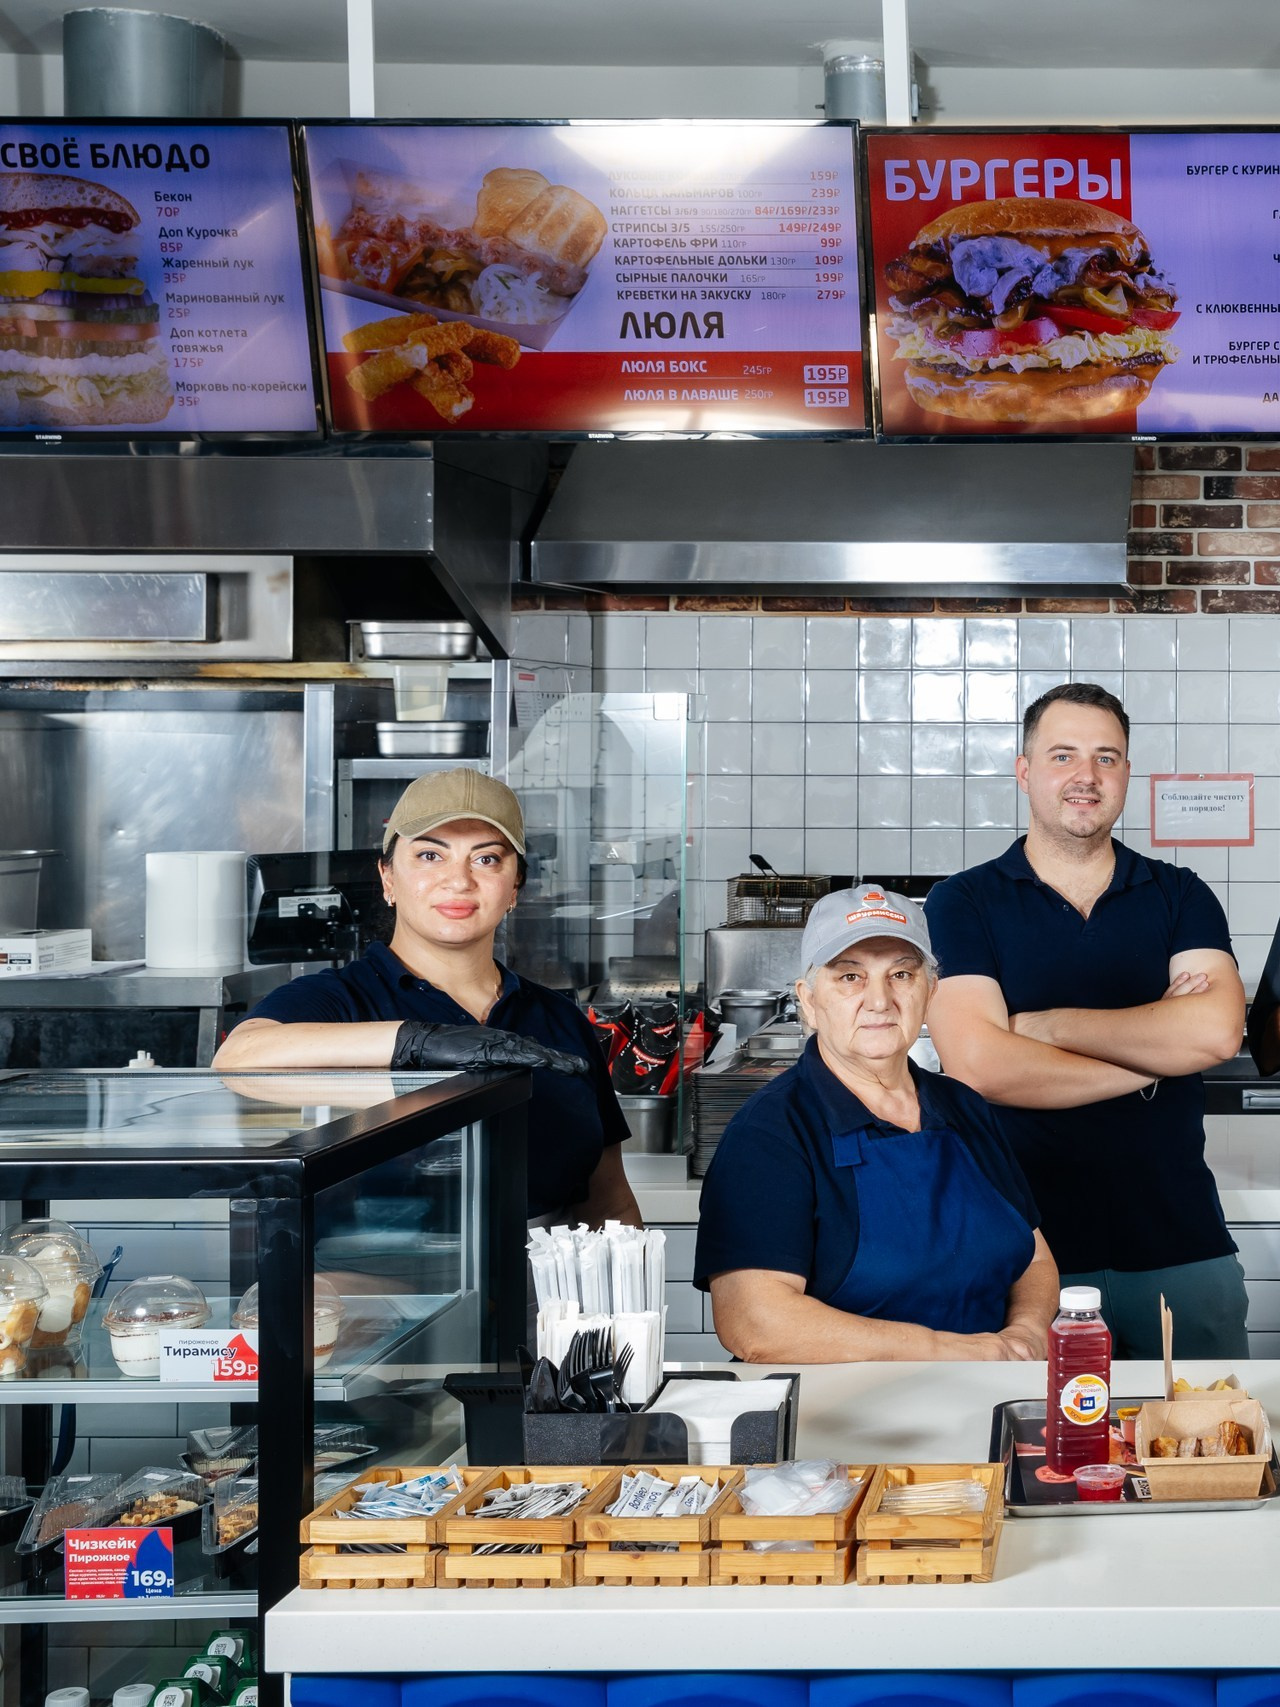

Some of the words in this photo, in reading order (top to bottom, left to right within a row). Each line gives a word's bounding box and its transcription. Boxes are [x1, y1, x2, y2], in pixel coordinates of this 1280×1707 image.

[1, 137, 80, 168] СВОЁ
[90, 143, 210, 172] БЛЮДО
[1186, 165, 1229, 175] БУРГЕР
[1232, 165, 1238, 175] С
[884, 159, 1122, 201] БУРГЕРЫ
[154, 191, 192, 202] Бекон
[611, 205, 671, 215] НАГГЕТСЫ
[158, 227, 183, 239] Доп
[187, 227, 238, 239] Курочка
[611, 223, 667, 233] СТРИПСЫ
[671, 223, 690, 233] 3/5
[613, 238, 687, 248] КАРТОФЕЛЬ
[690, 237, 718, 248] ФРИ
[162, 257, 229, 270] Жаренный
[235, 260, 254, 270] лук
[614, 255, 715, 266] КАРТОФЕЛЬНЫЕ
[717, 255, 768, 267] ДОЛЬКИ
[615, 273, 668, 283] СЫРНЫЕ
[671, 273, 728, 283] ПАЛОЧКИ
[166, 292, 259, 304] Маринованный
[264, 294, 285, 305] лук
[617, 290, 677, 300] КРЕВЕТКИ
[681, 290, 697, 300] НА
[700, 290, 752, 300] ЗАКУСКУ
[1196, 304, 1202, 313] С
[619, 311, 724, 339] ЛЮЛЯ
[170, 327, 196, 340] Доп
[198, 329, 248, 339] котлета
[171, 343, 224, 354] говяжья
[1229, 341, 1270, 350] БУРГЕР
[1274, 341, 1279, 350] С
[1193, 355, 1200, 364] И
[621, 361, 665, 373] ЛЮЛЯ
[669, 360, 707, 373] БОКС
[176, 381, 229, 393] Морковь
[232, 380, 307, 393] по-корейски
[624, 390, 665, 401] ЛЮЛЯ
[669, 390, 677, 401] В
[680, 389, 739, 401] ЛАВАШЕ
[1161, 793, 1211, 801] Соблюдайте
[1214, 794, 1245, 802] чистоту
[1189, 805, 1225, 813] порядок!
[164, 1346, 237, 1358] Тирамису
[68, 1537, 137, 1550] Чизкейк
[69, 1554, 130, 1564] Пирожное
